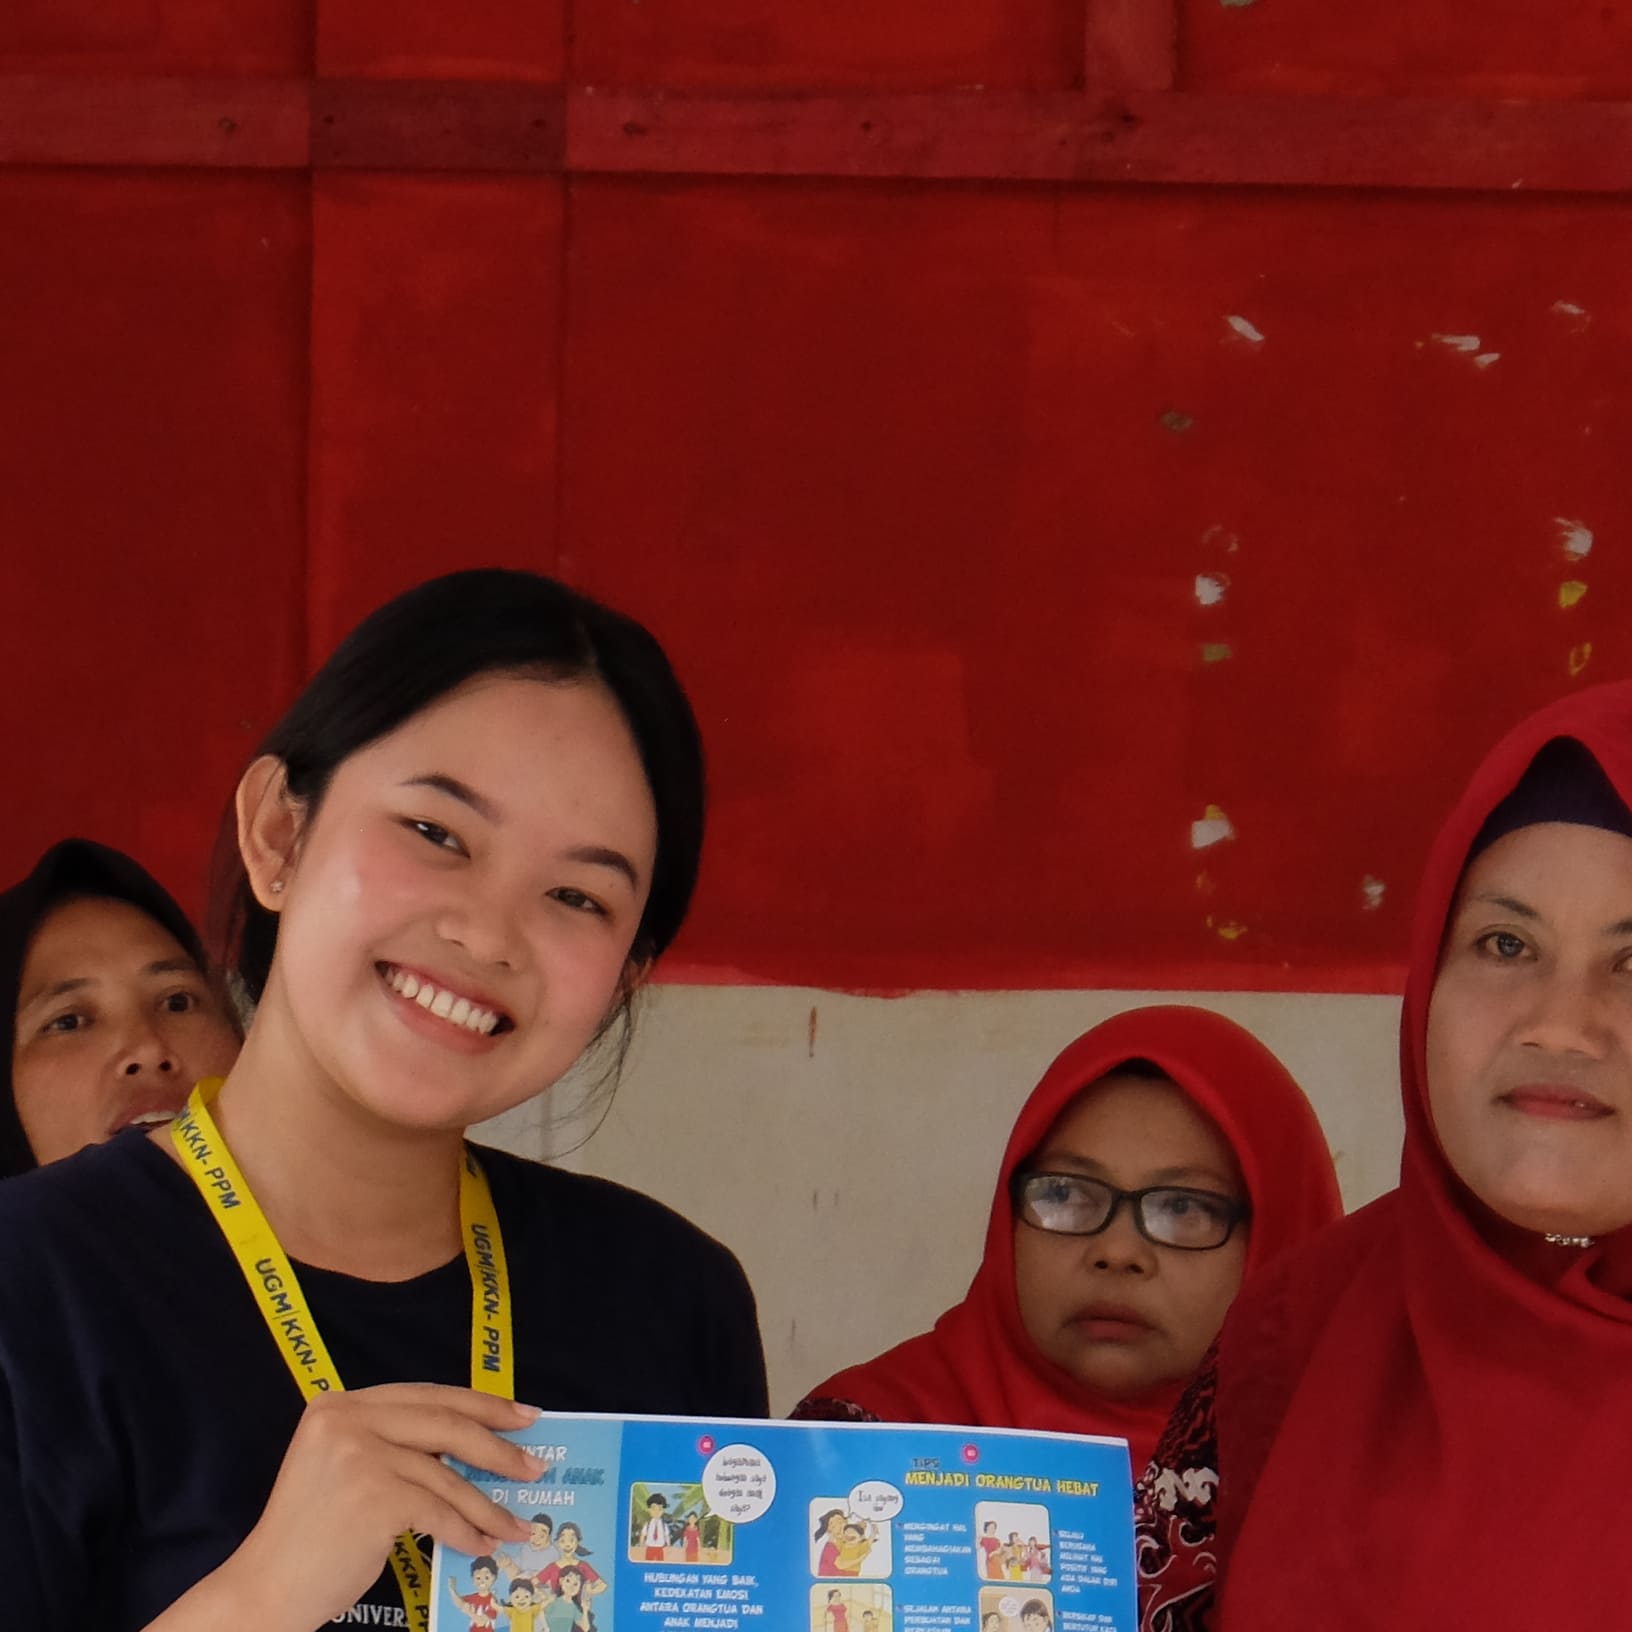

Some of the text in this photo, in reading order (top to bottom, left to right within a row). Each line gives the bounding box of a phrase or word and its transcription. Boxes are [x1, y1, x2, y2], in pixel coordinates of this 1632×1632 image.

[205, 1167, 241, 1210] PPM
[481, 1325, 501, 1373] PPM
[519, 1444, 567, 1462] NTAR
[904, 1472, 1099, 1497] MENJADI ORANGTUA HEBAT
[491, 1488, 575, 1506] DI RUMAH
[644, 1572, 699, 1584] HUBUNGAN
[702, 1574, 728, 1585] YANG
[654, 1587, 749, 1600] KEDEKATAN EMOSI
[640, 1602, 764, 1615] ANTARA ORANGTUA DAN
[664, 1617, 739, 1629] ANAK MENJADI
